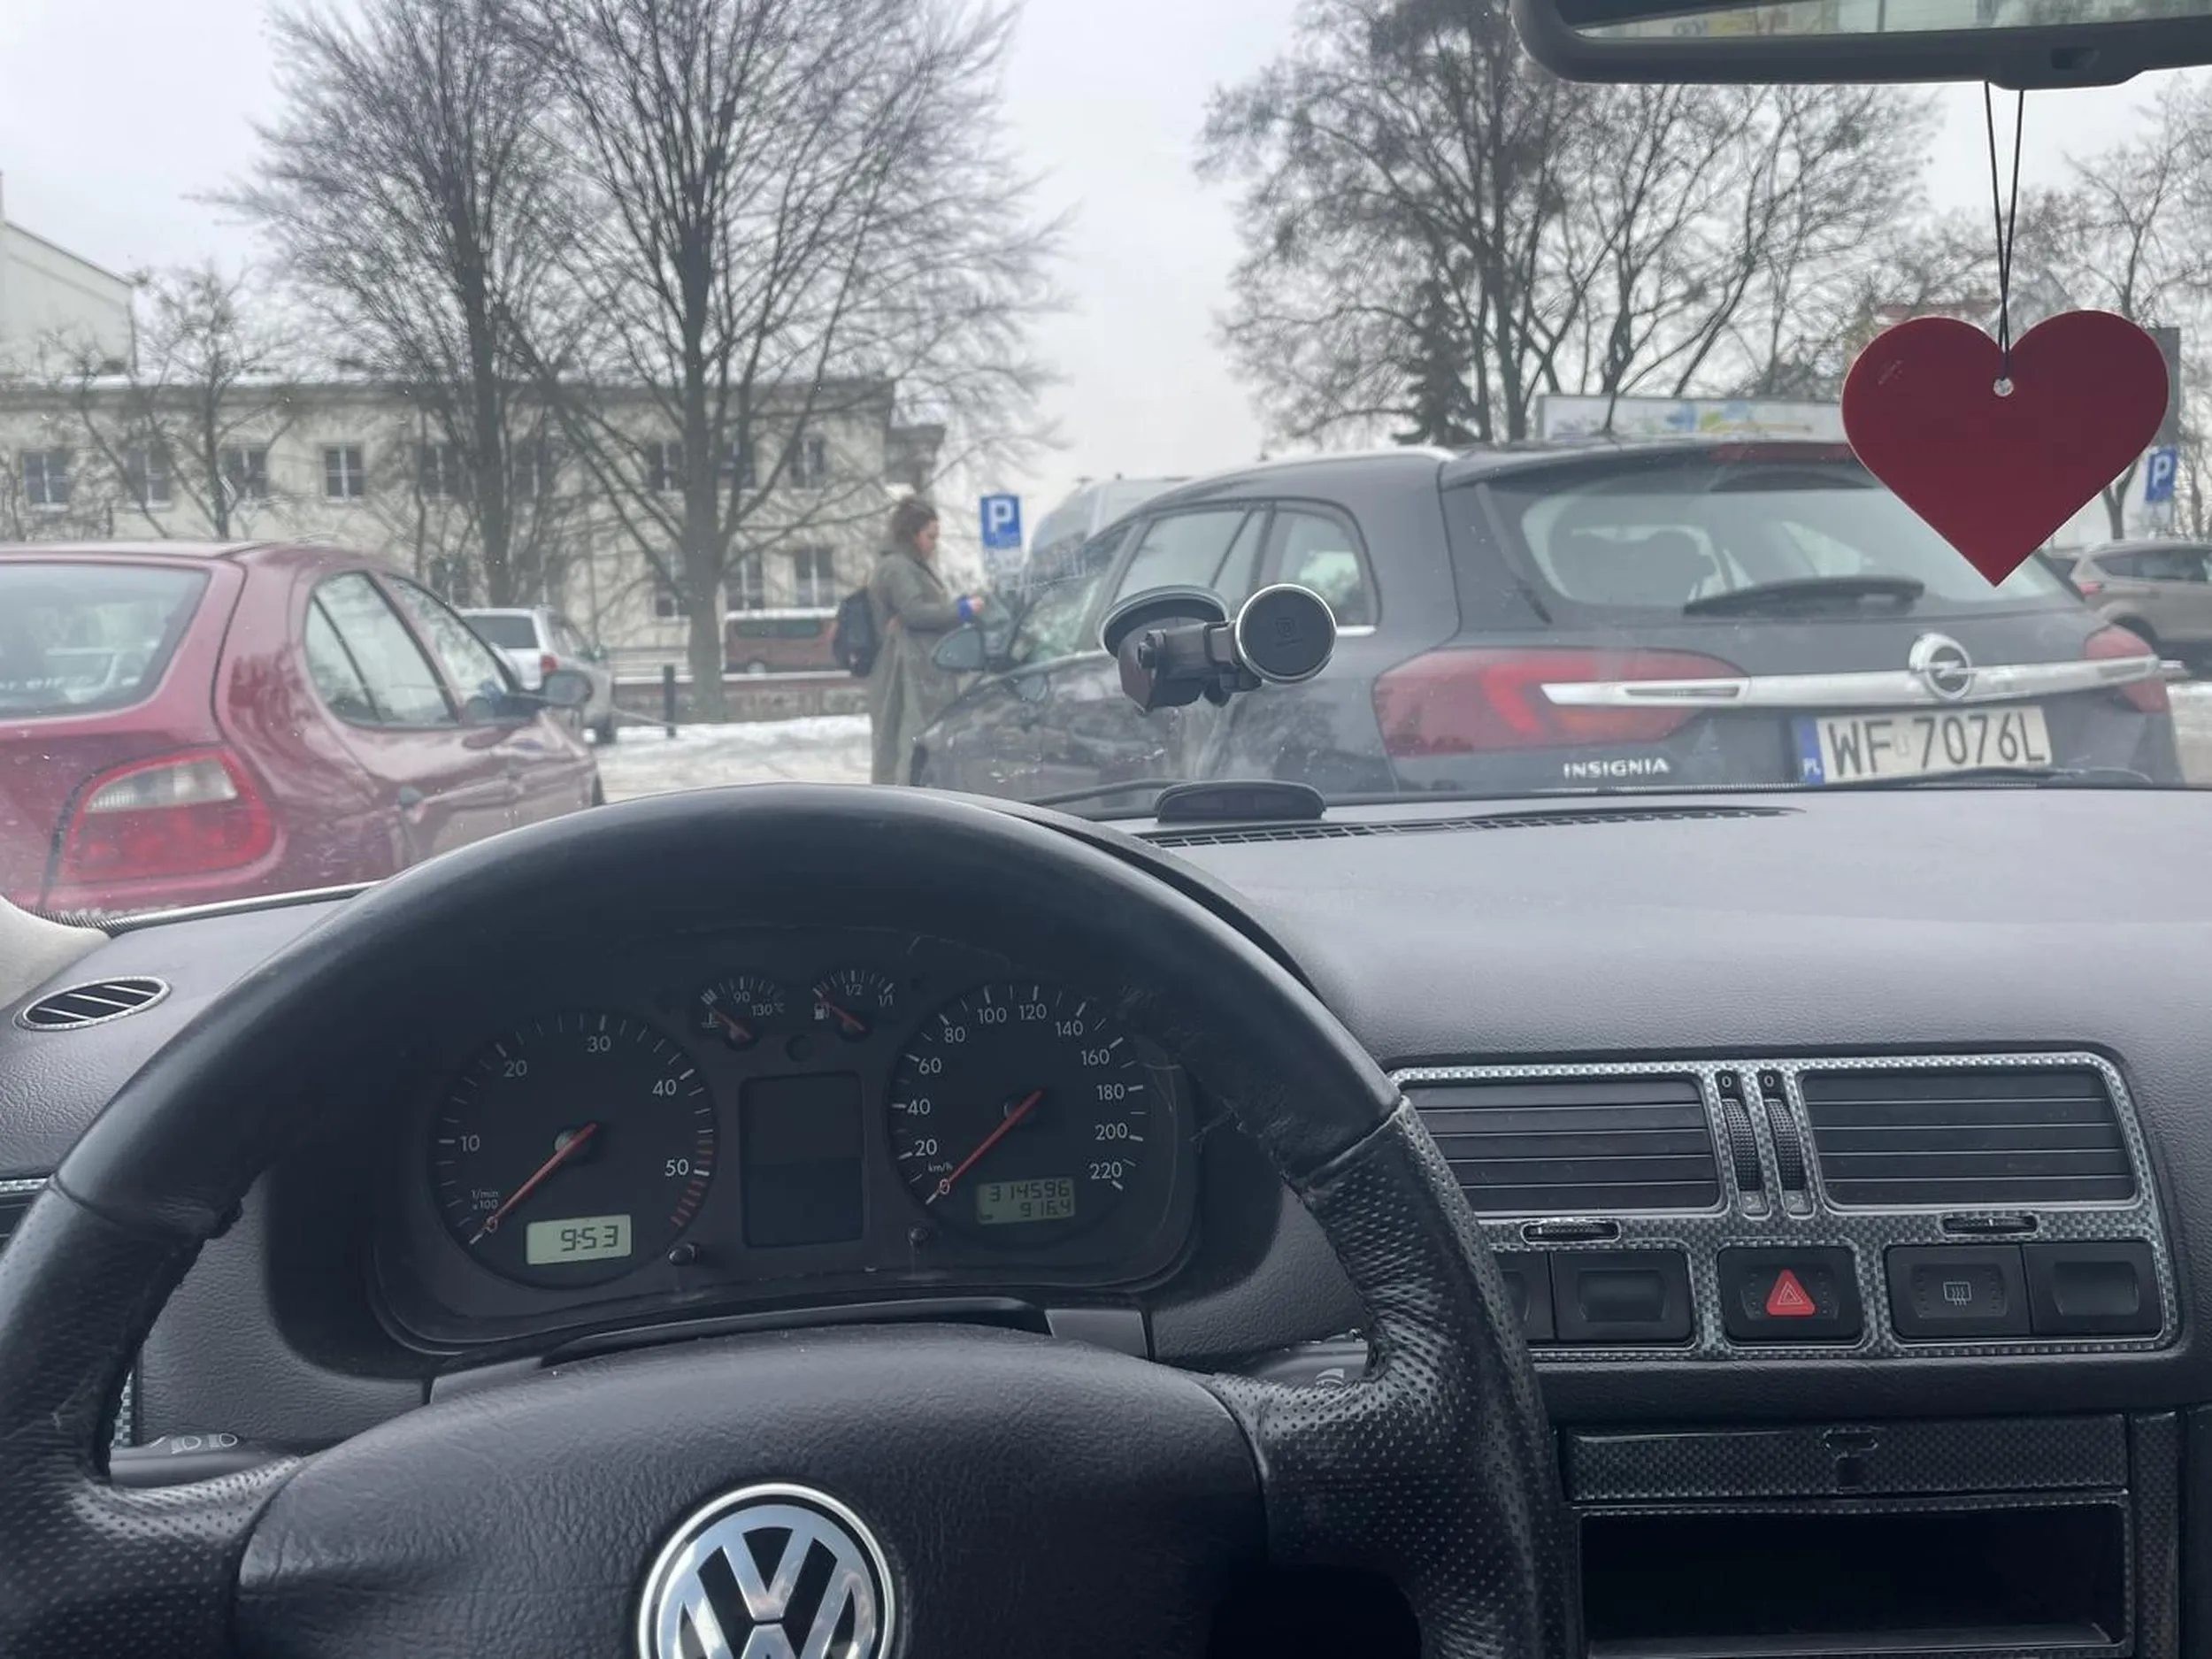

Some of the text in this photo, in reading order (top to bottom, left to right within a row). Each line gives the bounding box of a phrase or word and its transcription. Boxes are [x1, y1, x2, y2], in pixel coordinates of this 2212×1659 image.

[2152, 455, 2172, 488] P
[988, 499, 1015, 533] P
[1827, 711, 2046, 776] WF 7076L
[1563, 757, 1671, 779] INSIGNIA
[1803, 757, 1822, 777] PL
[733, 991, 751, 1003] 90
[977, 1007, 1008, 1025] 100
[1018, 1003, 1048, 1020] 120
[944, 1026, 966, 1043] 80
[1055, 1020, 1084, 1037] 140
[588, 1036, 611, 1053] 30
[918, 1058, 942, 1074] 60
[1080, 1049, 1110, 1067] 160
[503, 1061, 527, 1078] 20
[652, 1079, 677, 1096] 40
[1096, 1083, 1125, 1101] 180
[907, 1099, 931, 1116] 40
[1094, 1123, 1128, 1141] 200
[460, 1136, 480, 1151] 10
[915, 1139, 938, 1156] 20
[665, 1159, 689, 1176] 50
[929, 1162, 953, 1173] km/h
[1089, 1162, 1123, 1180] 220
[560, 1225, 618, 1252] 9:53
